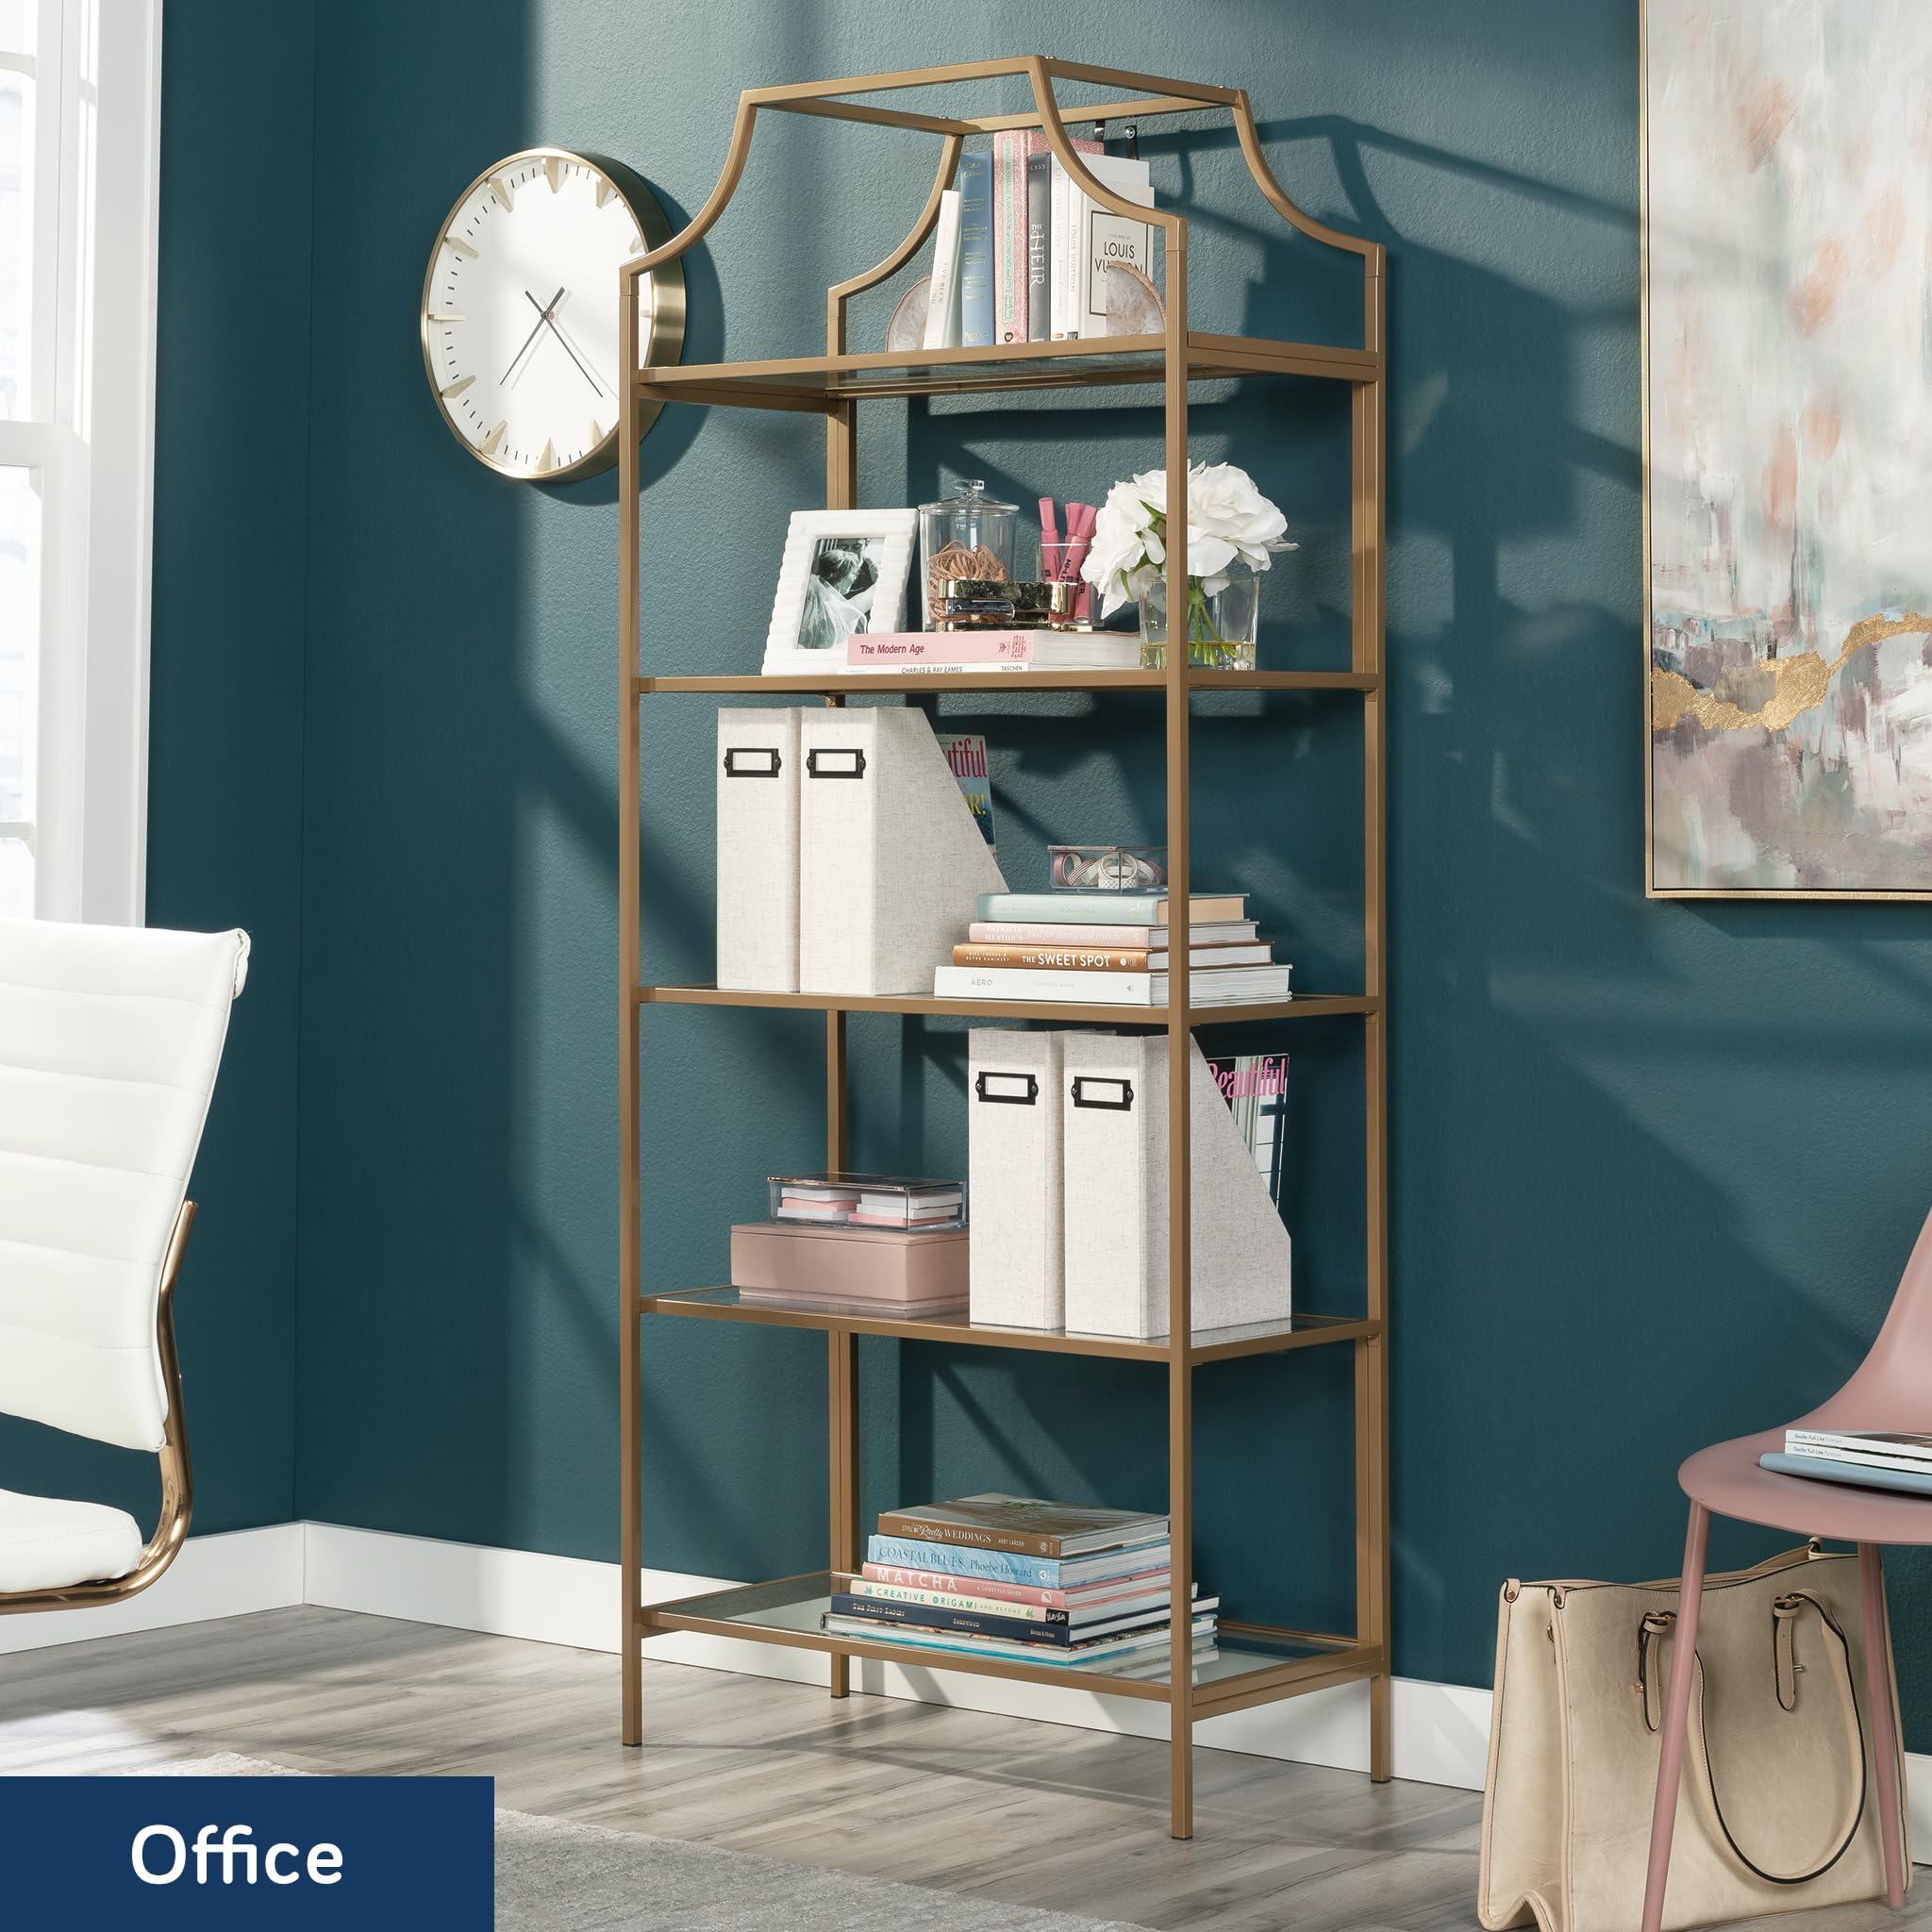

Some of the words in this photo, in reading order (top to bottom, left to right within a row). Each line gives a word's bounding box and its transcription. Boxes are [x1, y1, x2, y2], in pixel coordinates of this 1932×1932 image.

[1104, 241, 1135, 259] LOUIS
[860, 644, 874, 654] The
[877, 644, 907, 654] Modern
[909, 643, 924, 656] Age
[1038, 953, 1076, 967] SWEET
[1079, 955, 1110, 968] SPOT
[971, 978, 992, 987] AERO
[916, 1523, 943, 1541] Pretty
[943, 1528, 991, 1543] WEDDINGS
[879, 1546, 928, 1563] COASTAL
[930, 1553, 963, 1568] BLUES
[970, 1559, 998, 1573] Phoebe
[1000, 1563, 1032, 1578] Howard
[877, 1568, 958, 1591] MATCHA
[981, 1587, 1006, 1595] LIFESTYLE
[876, 1588, 925, 1602] CREATIVE
[932, 1596, 977, 1610] ORIGAMI
[995, 1607, 1022, 1615] BEYOND
